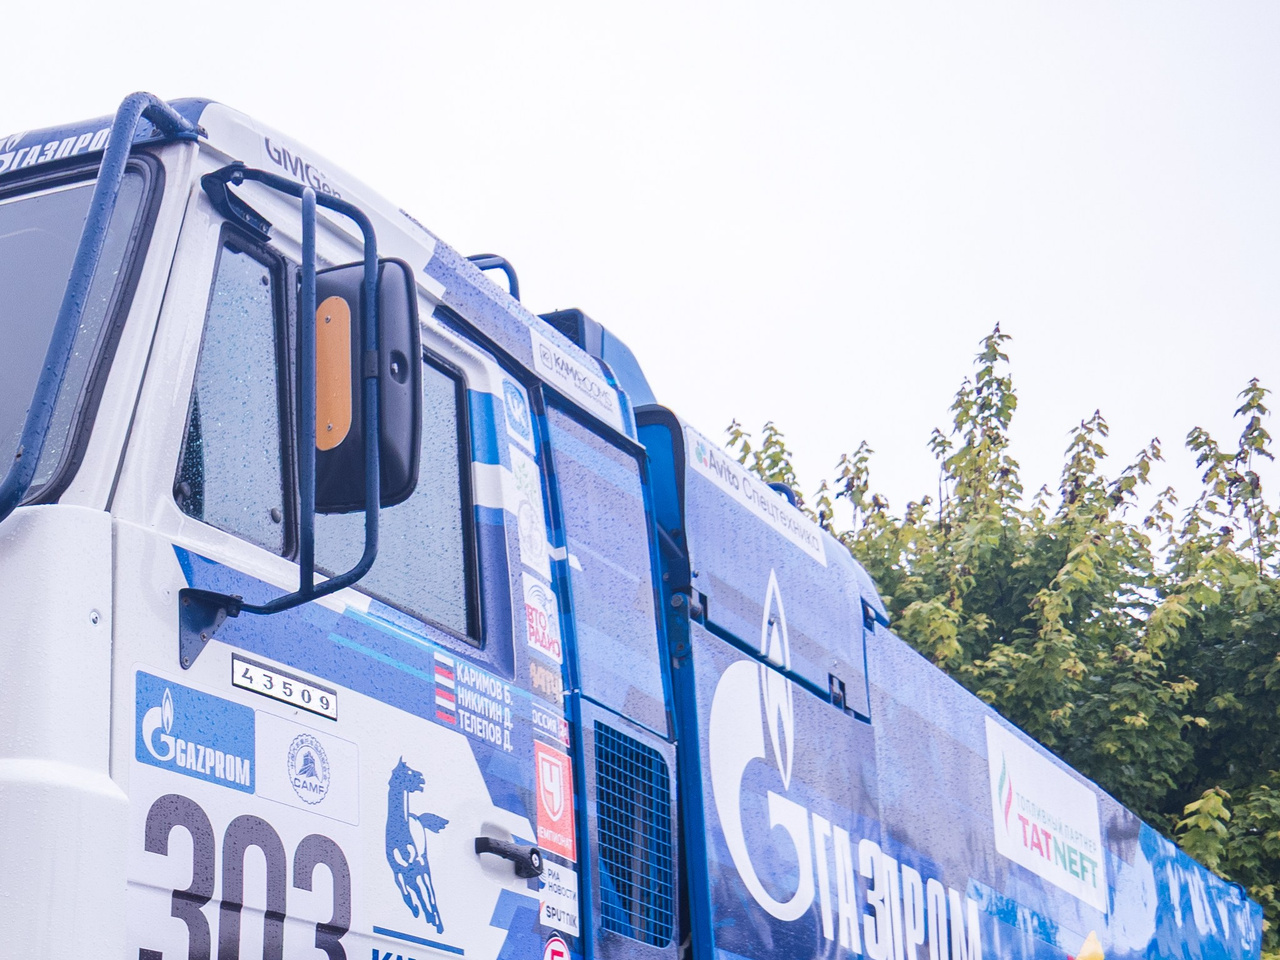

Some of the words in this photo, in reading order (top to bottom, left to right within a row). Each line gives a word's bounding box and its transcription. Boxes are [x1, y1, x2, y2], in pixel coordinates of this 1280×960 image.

[10, 127, 111, 171] ГАЗПРО
[524, 603, 547, 631] ВТО
[241, 667, 331, 711] 43509
[456, 661, 503, 700] КАРИМОВ
[457, 685, 503, 724] НИКИТИН
[531, 709, 558, 734] ОССИЯ
[458, 708, 503, 745] ТЕЛЕПОВ
[175, 736, 251, 787] GAZPROM
[293, 777, 325, 795] CAMF
[1017, 813, 1099, 889] TATNEFT
[547, 868, 561, 883] РИА
[547, 882, 577, 902] НОВОСТИ
